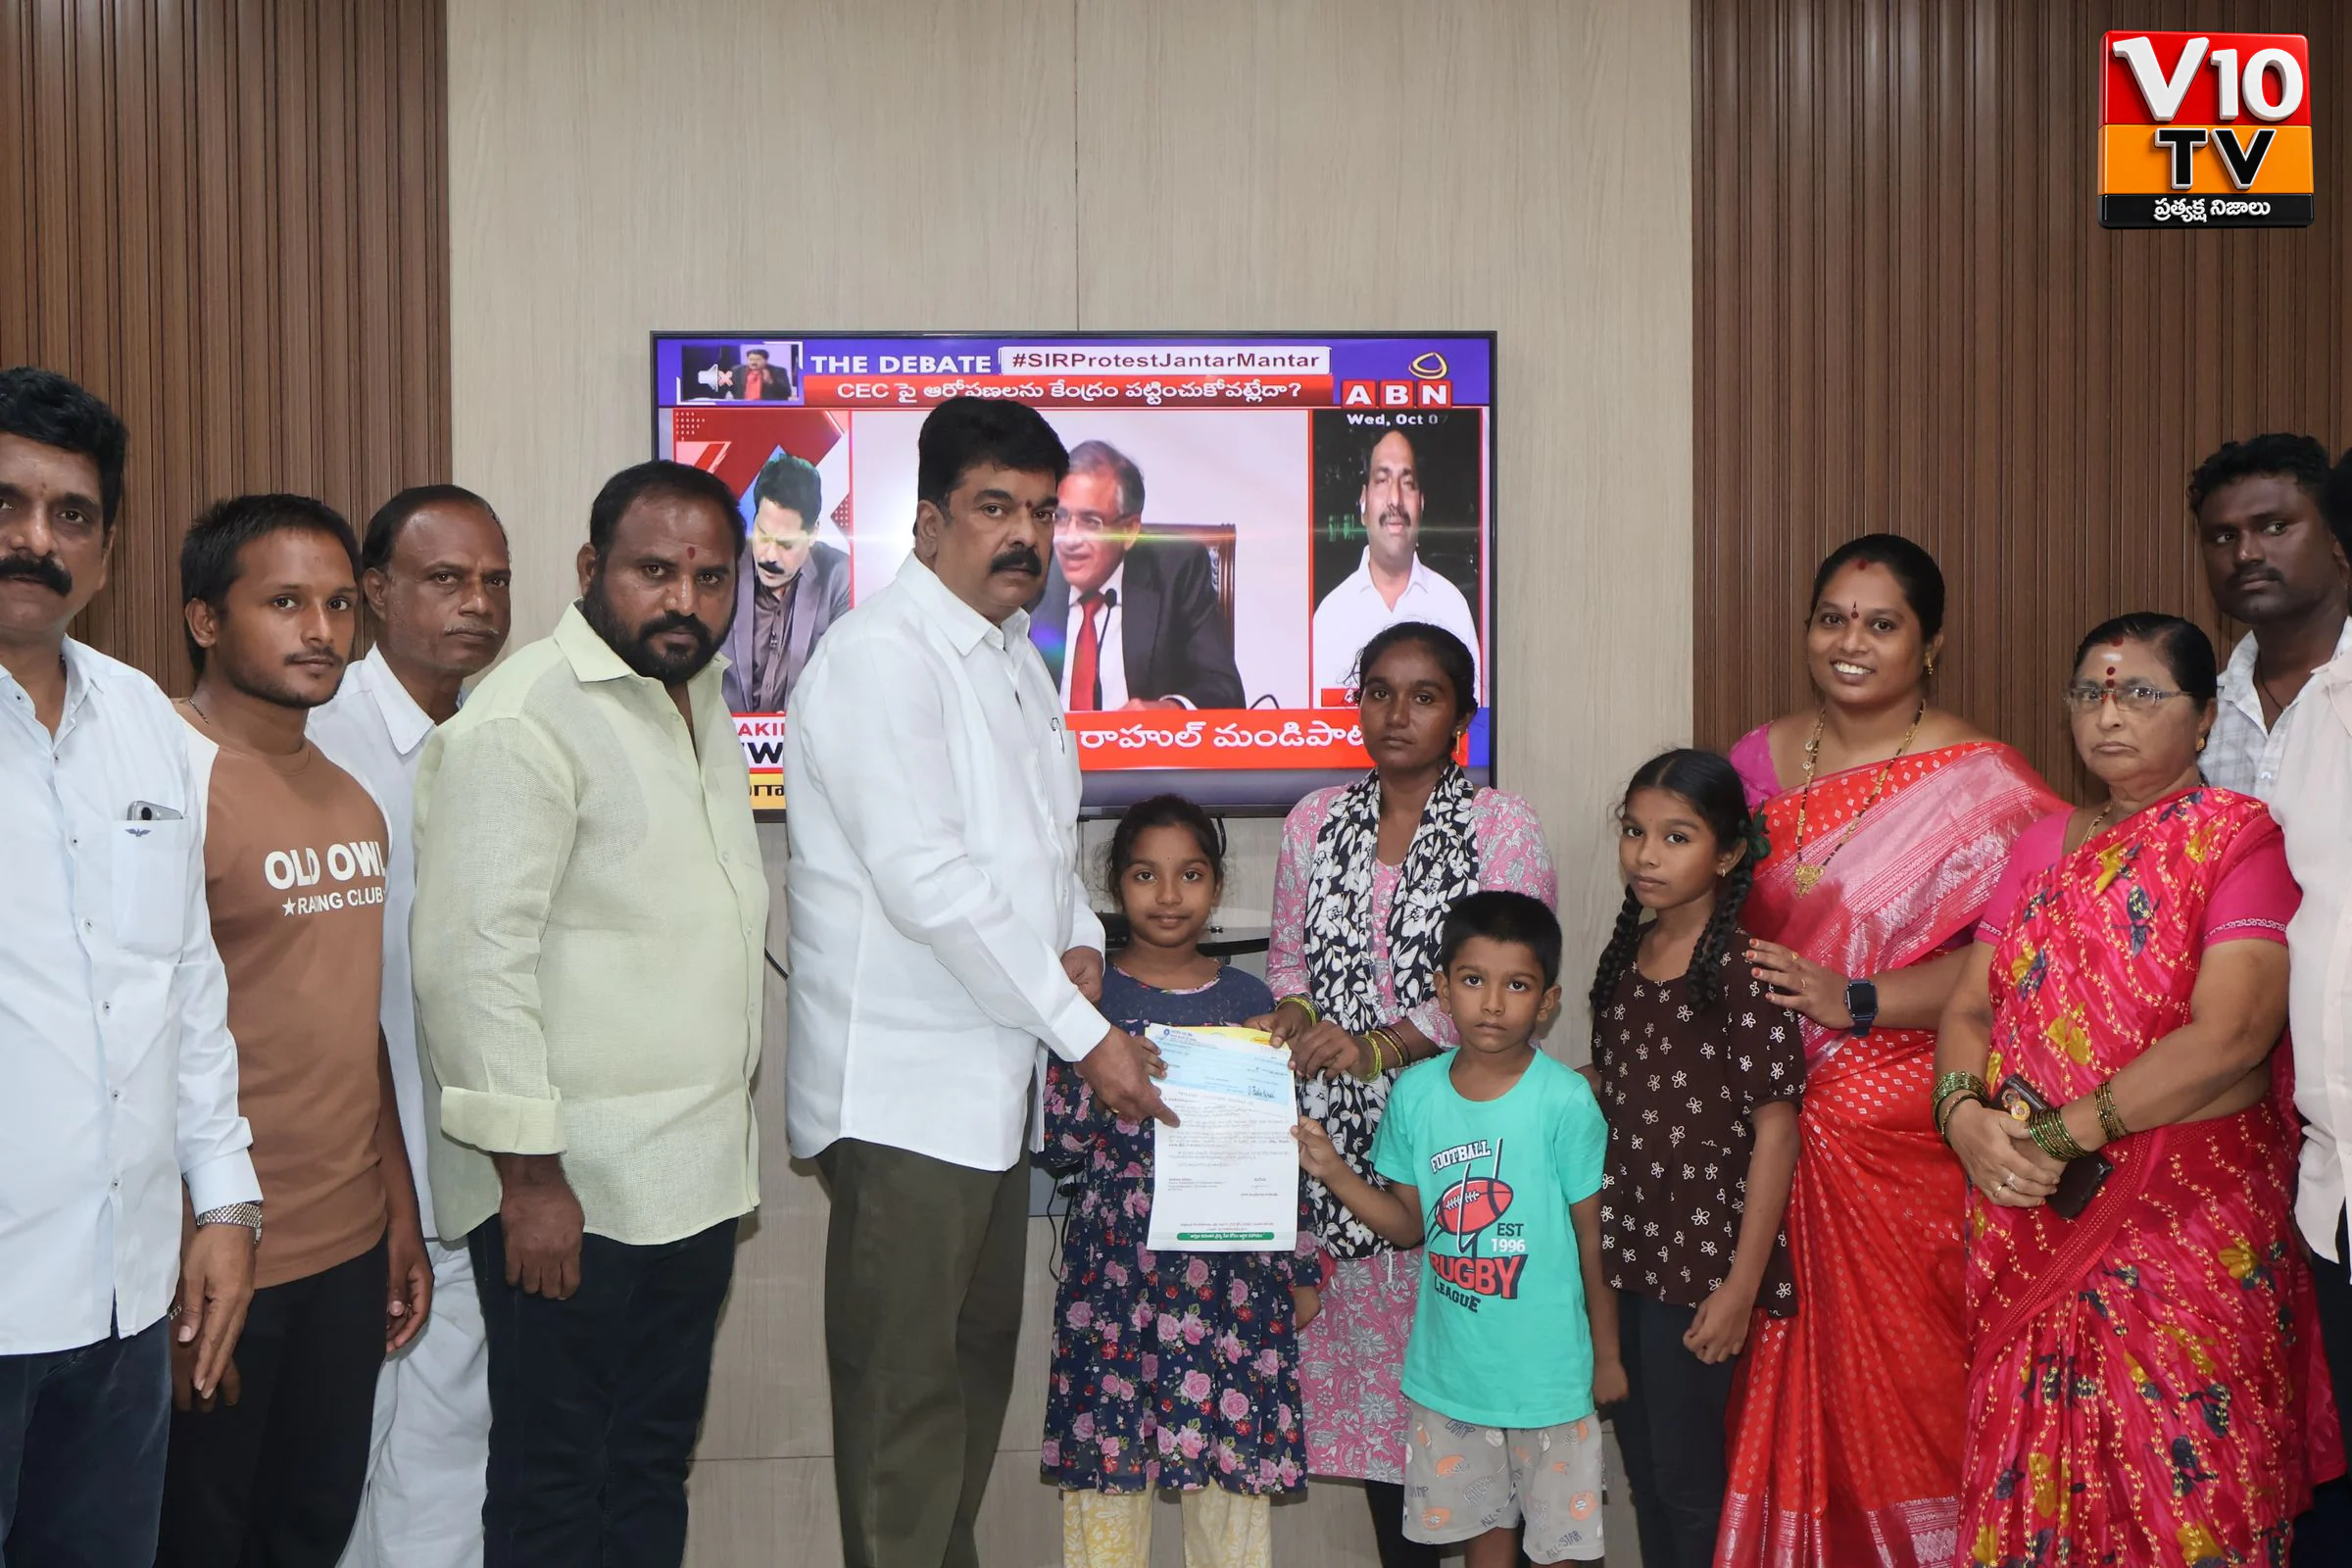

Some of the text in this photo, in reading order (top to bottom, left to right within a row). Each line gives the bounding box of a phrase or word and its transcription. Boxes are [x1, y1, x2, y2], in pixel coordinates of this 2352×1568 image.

[810, 353, 1319, 373] THE DEBATE #SIRProtestJantarMantar
[837, 383, 890, 399] CEC
[894, 383, 917, 404] పై
[1049, 379, 1119, 401] కేంద్రం
[1346, 385, 1447, 405] ABN
[1347, 414, 1392, 426] Wed,
[1396, 414, 1424, 425] Oct
[1080, 720, 1206, 748] రాహుల్
[265, 841, 386, 890] OLD OWL
[347, 886, 384, 906] CLUB
[1430, 1140, 1492, 1175] FOOTBALL
[1496, 1223, 1525, 1237] EST
[1492, 1239, 1526, 1252] 1996
[1428, 1251, 1529, 1299] RUGBY
[1434, 1275, 1481, 1313] LEAGUE
